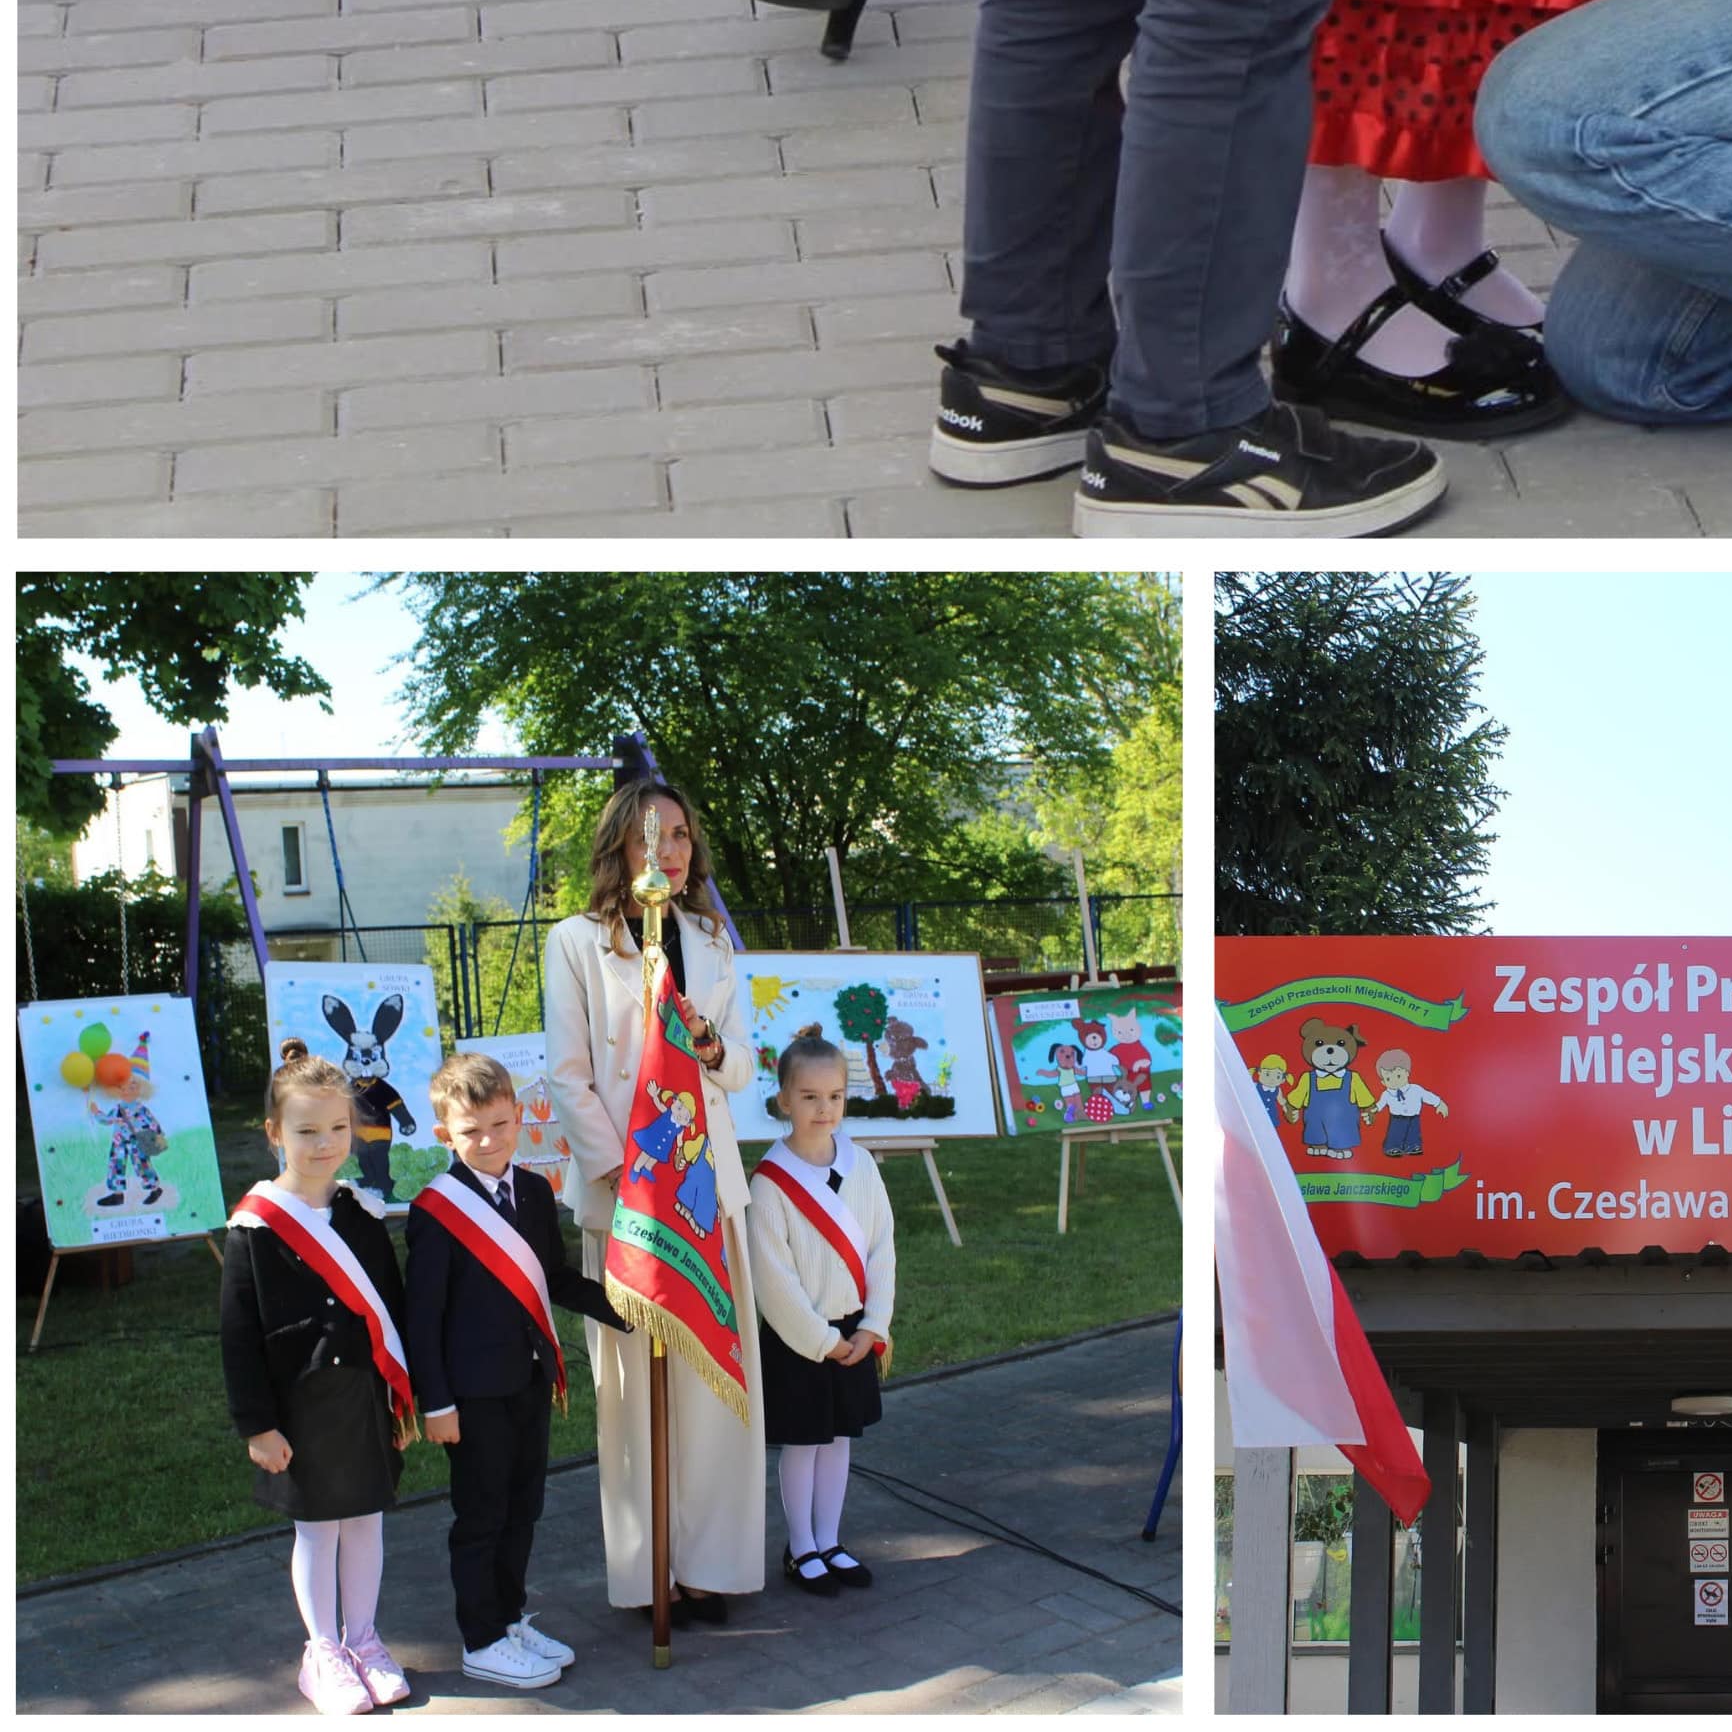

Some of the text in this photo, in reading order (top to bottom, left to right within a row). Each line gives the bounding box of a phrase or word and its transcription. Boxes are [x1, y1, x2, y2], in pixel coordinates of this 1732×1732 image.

[1239, 439, 1281, 462] Reebok
[1287, 985, 1352, 1001] Przedszkoli
[1355, 985, 1407, 1006] Miejskich
[1408, 1002, 1421, 1012] nr
[1423, 1009, 1429, 1017] 1
[1494, 963, 1674, 1026] Zespół
[1632, 1119, 1678, 1155] w
[1301, 1179, 1410, 1198] sława Janczarskiego
[1475, 1180, 1536, 1220] im.
[1548, 1179, 1730, 1220] Czesława
[627, 1220, 728, 1319] Czesława Janczarskiego
